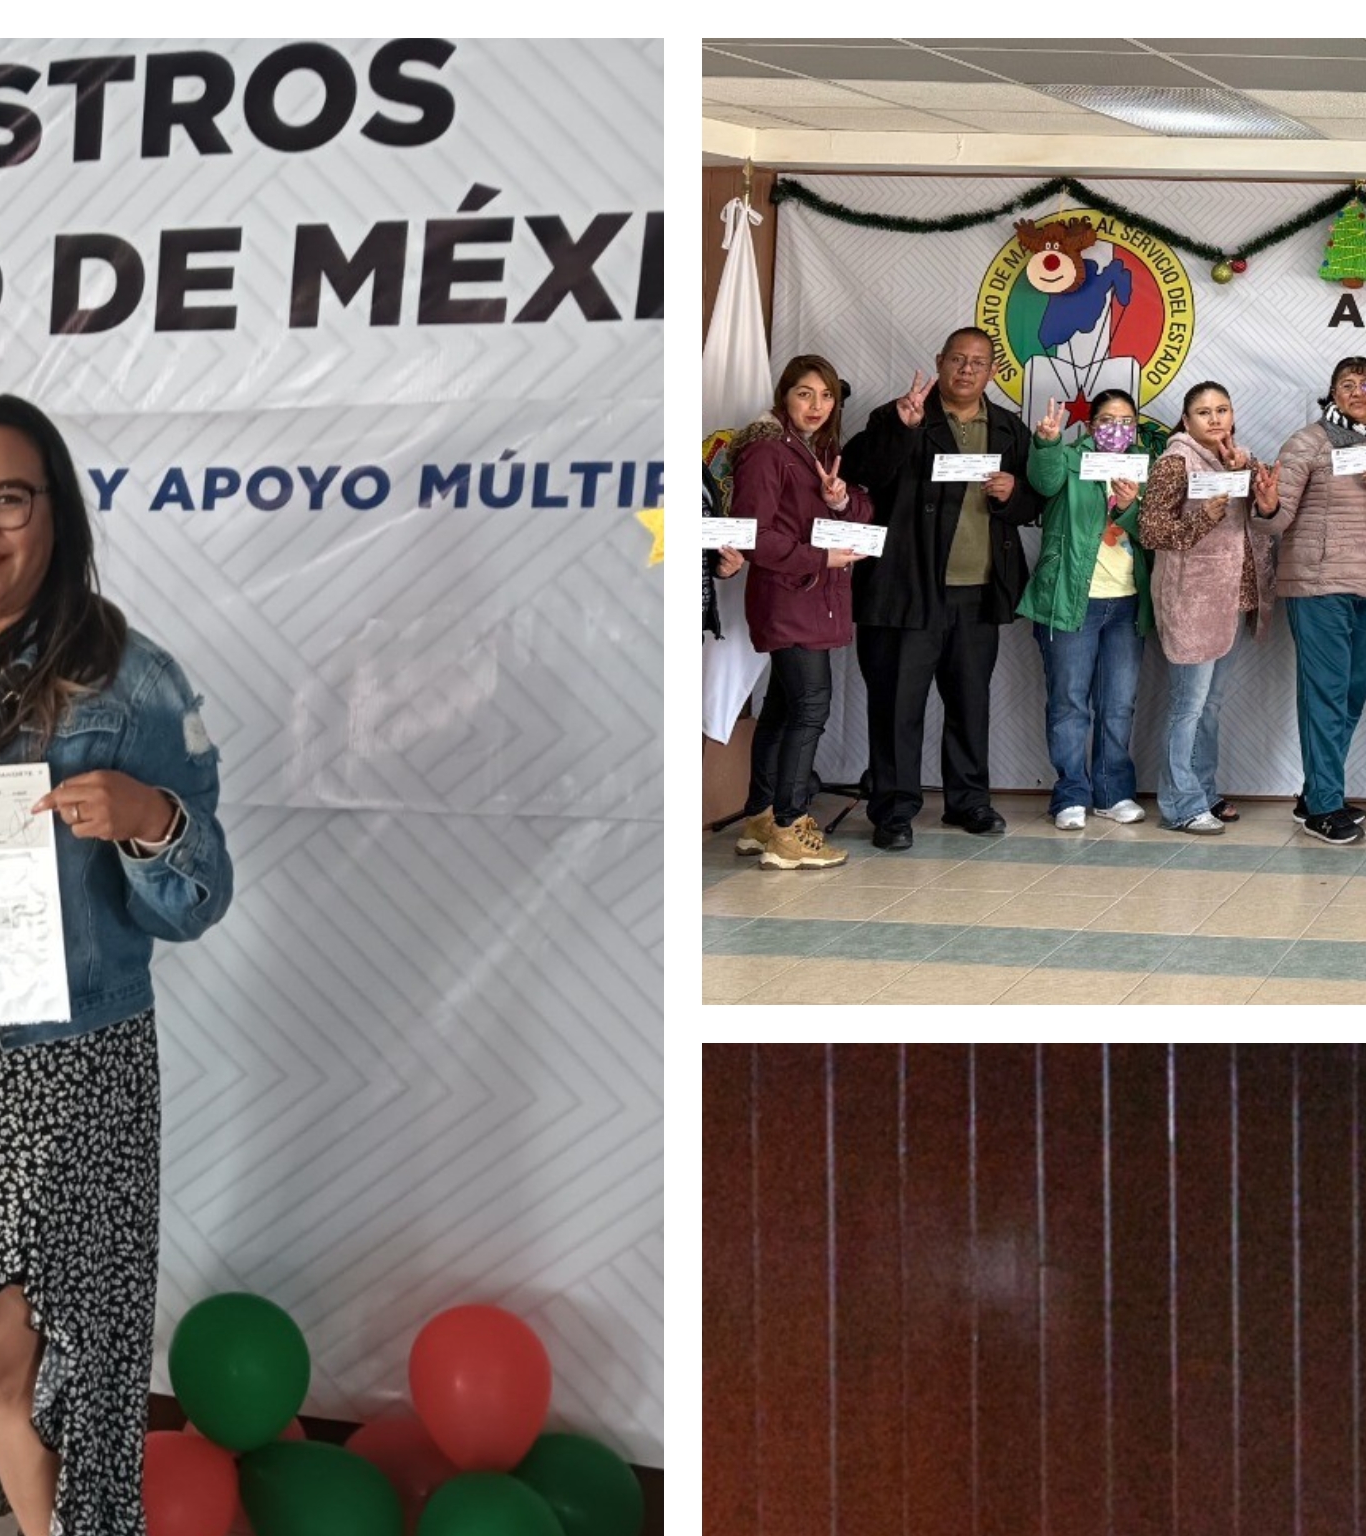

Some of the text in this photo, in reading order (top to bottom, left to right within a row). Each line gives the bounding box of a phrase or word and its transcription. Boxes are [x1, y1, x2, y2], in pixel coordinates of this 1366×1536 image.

[1096, 217, 1116, 236] AL
[49, 226, 243, 337] DE
[289, 182, 664, 330] MÉXI
[989, 267, 1011, 291] DE
[1120, 225, 1180, 285] SERVICIO
[1167, 287, 1187, 318] DEL
[1146, 322, 1187, 385] ESTADO
[86, 467, 129, 512] Y
[149, 463, 391, 512] APOYO
